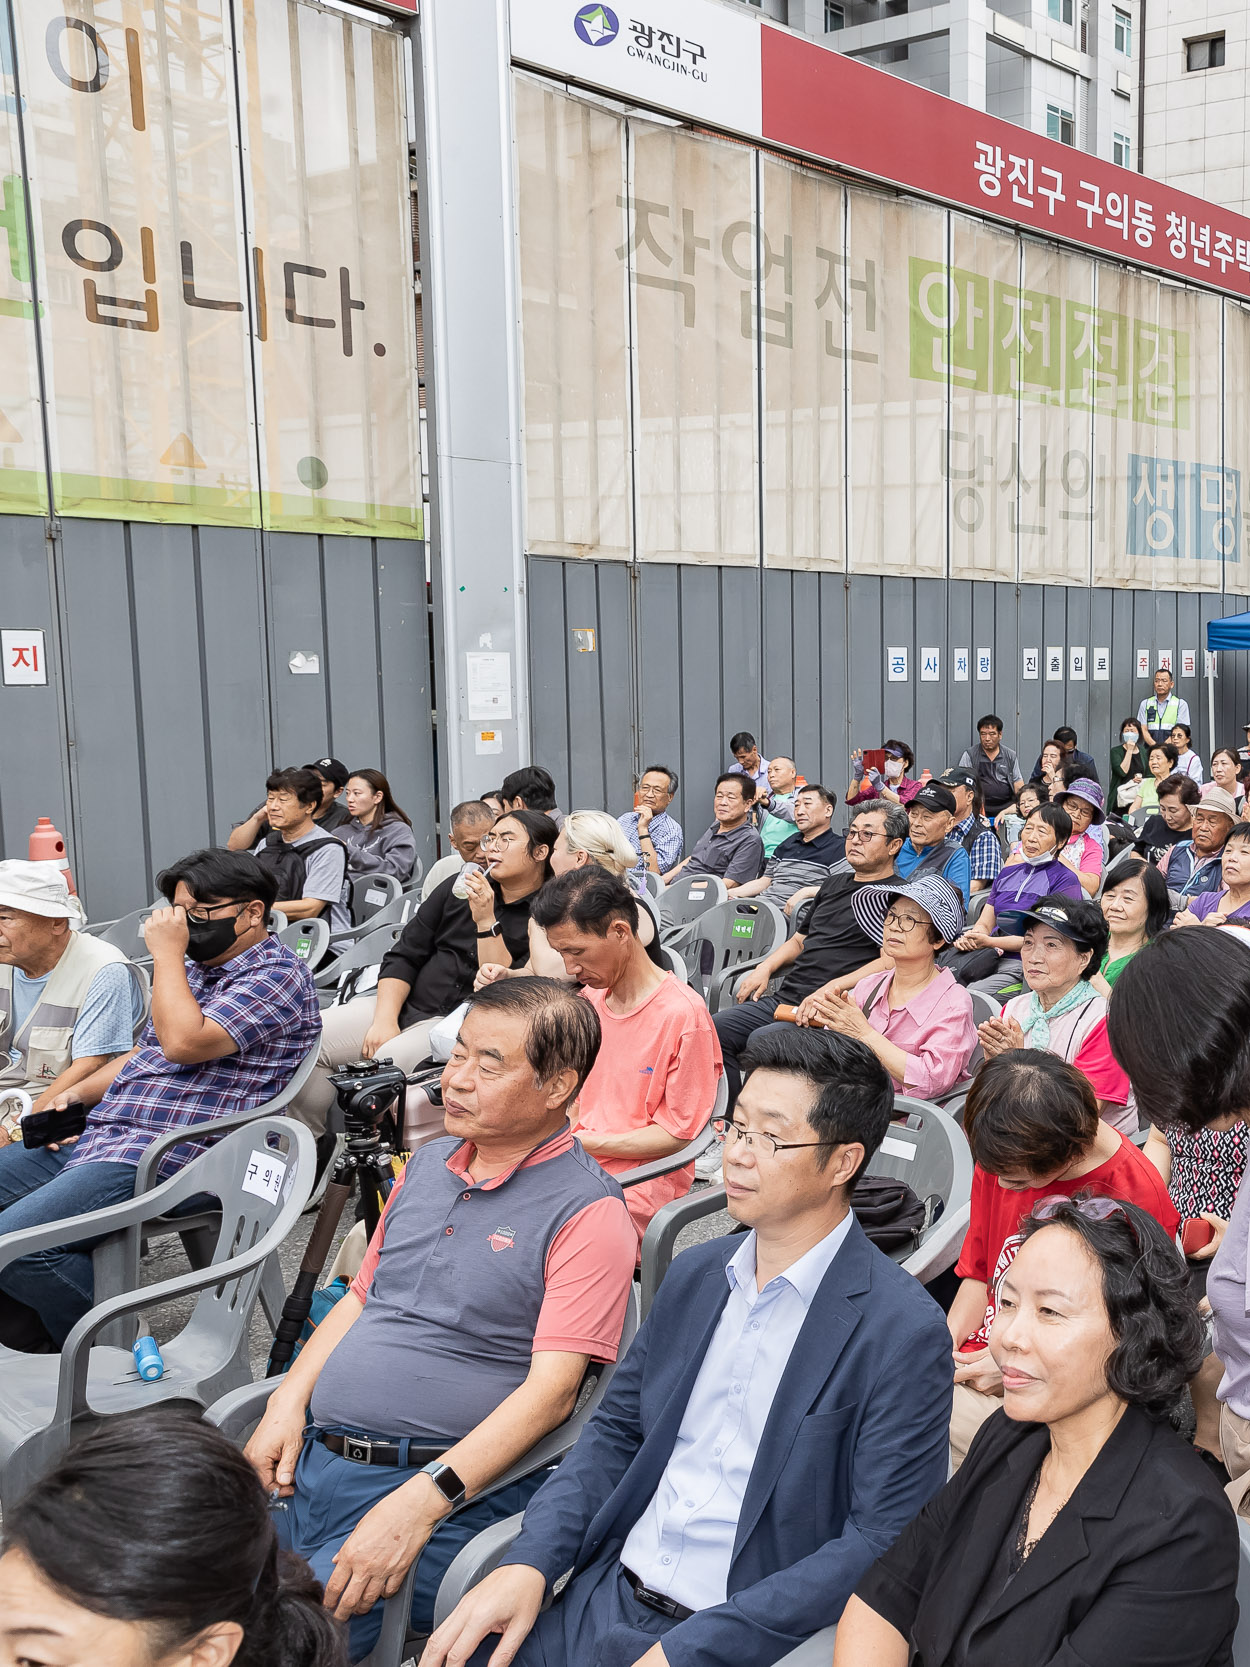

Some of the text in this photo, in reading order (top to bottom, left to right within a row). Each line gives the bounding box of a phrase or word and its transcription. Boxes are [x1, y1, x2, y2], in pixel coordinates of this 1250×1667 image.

[627, 17, 707, 65] 광진구
[626, 45, 709, 83] GWANGJIN-GU
[973, 140, 1066, 216] 광진구
[1076, 179, 1157, 249] 구의동
[916, 269, 1179, 426] 안전점검
[937, 427, 1108, 544] 당신의
[11, 644, 39, 672] 지
[890, 655, 991, 674] 공사차량
[1026, 655, 1107, 672] 진출입로
